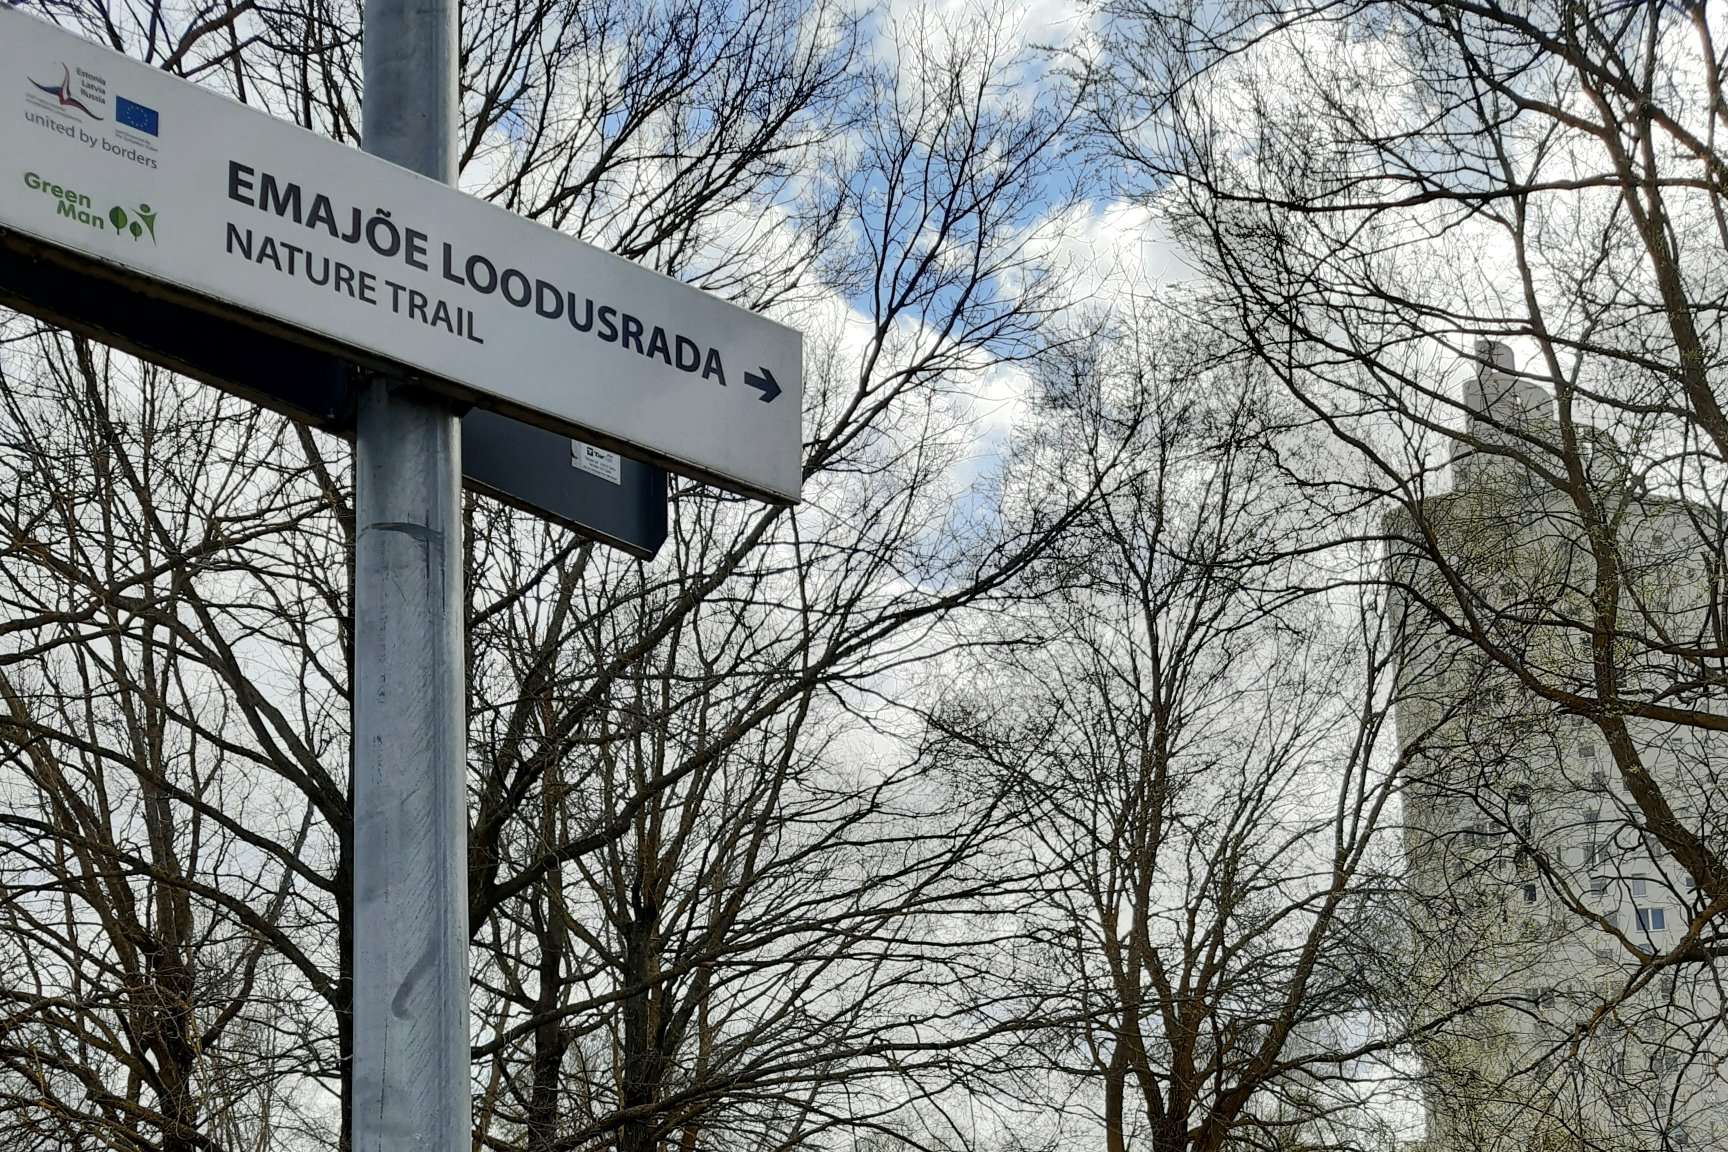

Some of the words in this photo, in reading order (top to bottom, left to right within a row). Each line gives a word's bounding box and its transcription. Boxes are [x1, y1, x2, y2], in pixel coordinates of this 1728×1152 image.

[25, 111, 75, 138] united
[80, 129, 98, 148] by
[102, 138, 158, 169] borders
[24, 171, 91, 209] Green
[57, 200, 104, 229] Man
[226, 222, 377, 305] NATURE
[385, 280, 484, 344] TRAIL
[228, 160, 428, 271] EMAJÕE
[443, 242, 727, 386] LOODUSRADA
